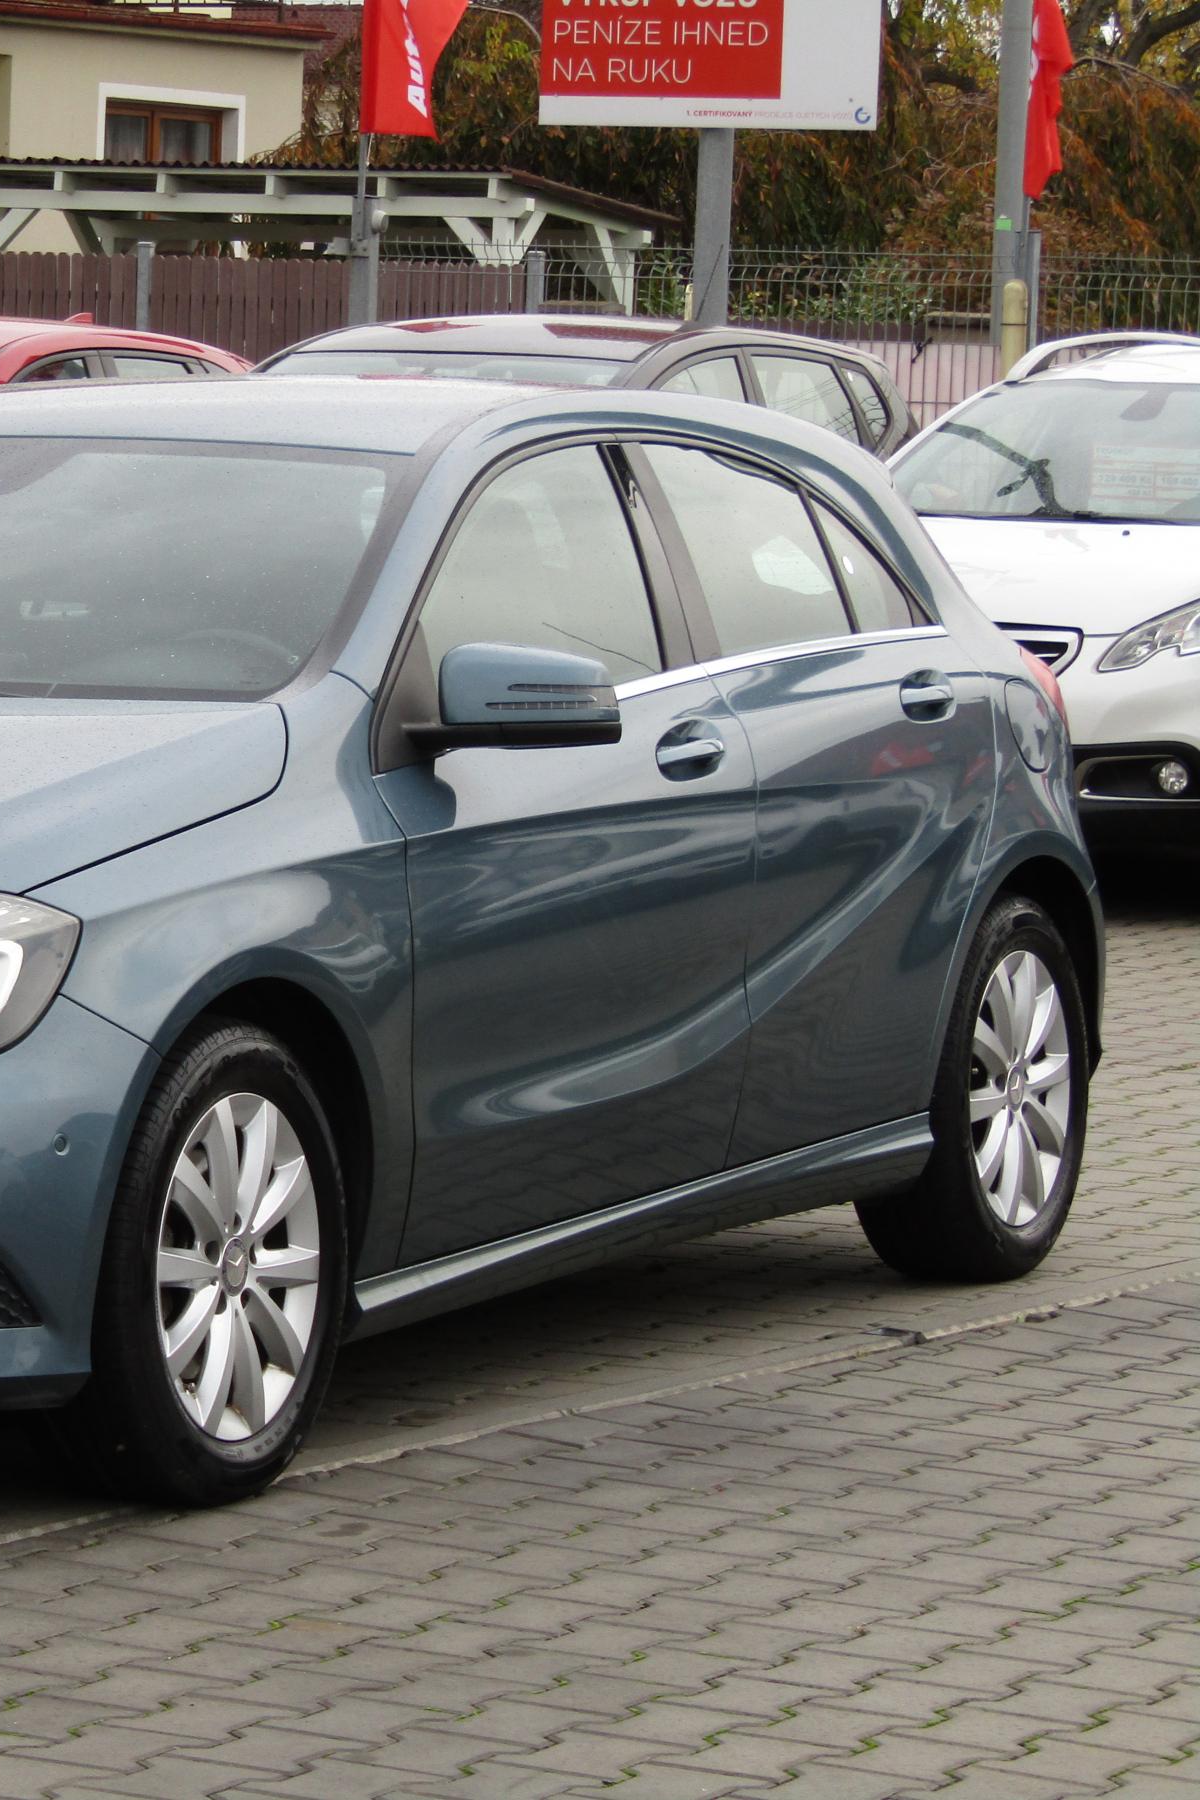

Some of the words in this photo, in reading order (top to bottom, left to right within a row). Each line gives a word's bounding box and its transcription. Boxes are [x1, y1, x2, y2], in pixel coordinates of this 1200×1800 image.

[553, 15, 662, 45] PENÍZE
[673, 20, 769, 46] IHNED
[552, 57, 596, 83] NA
[607, 58, 692, 84] RUKU
